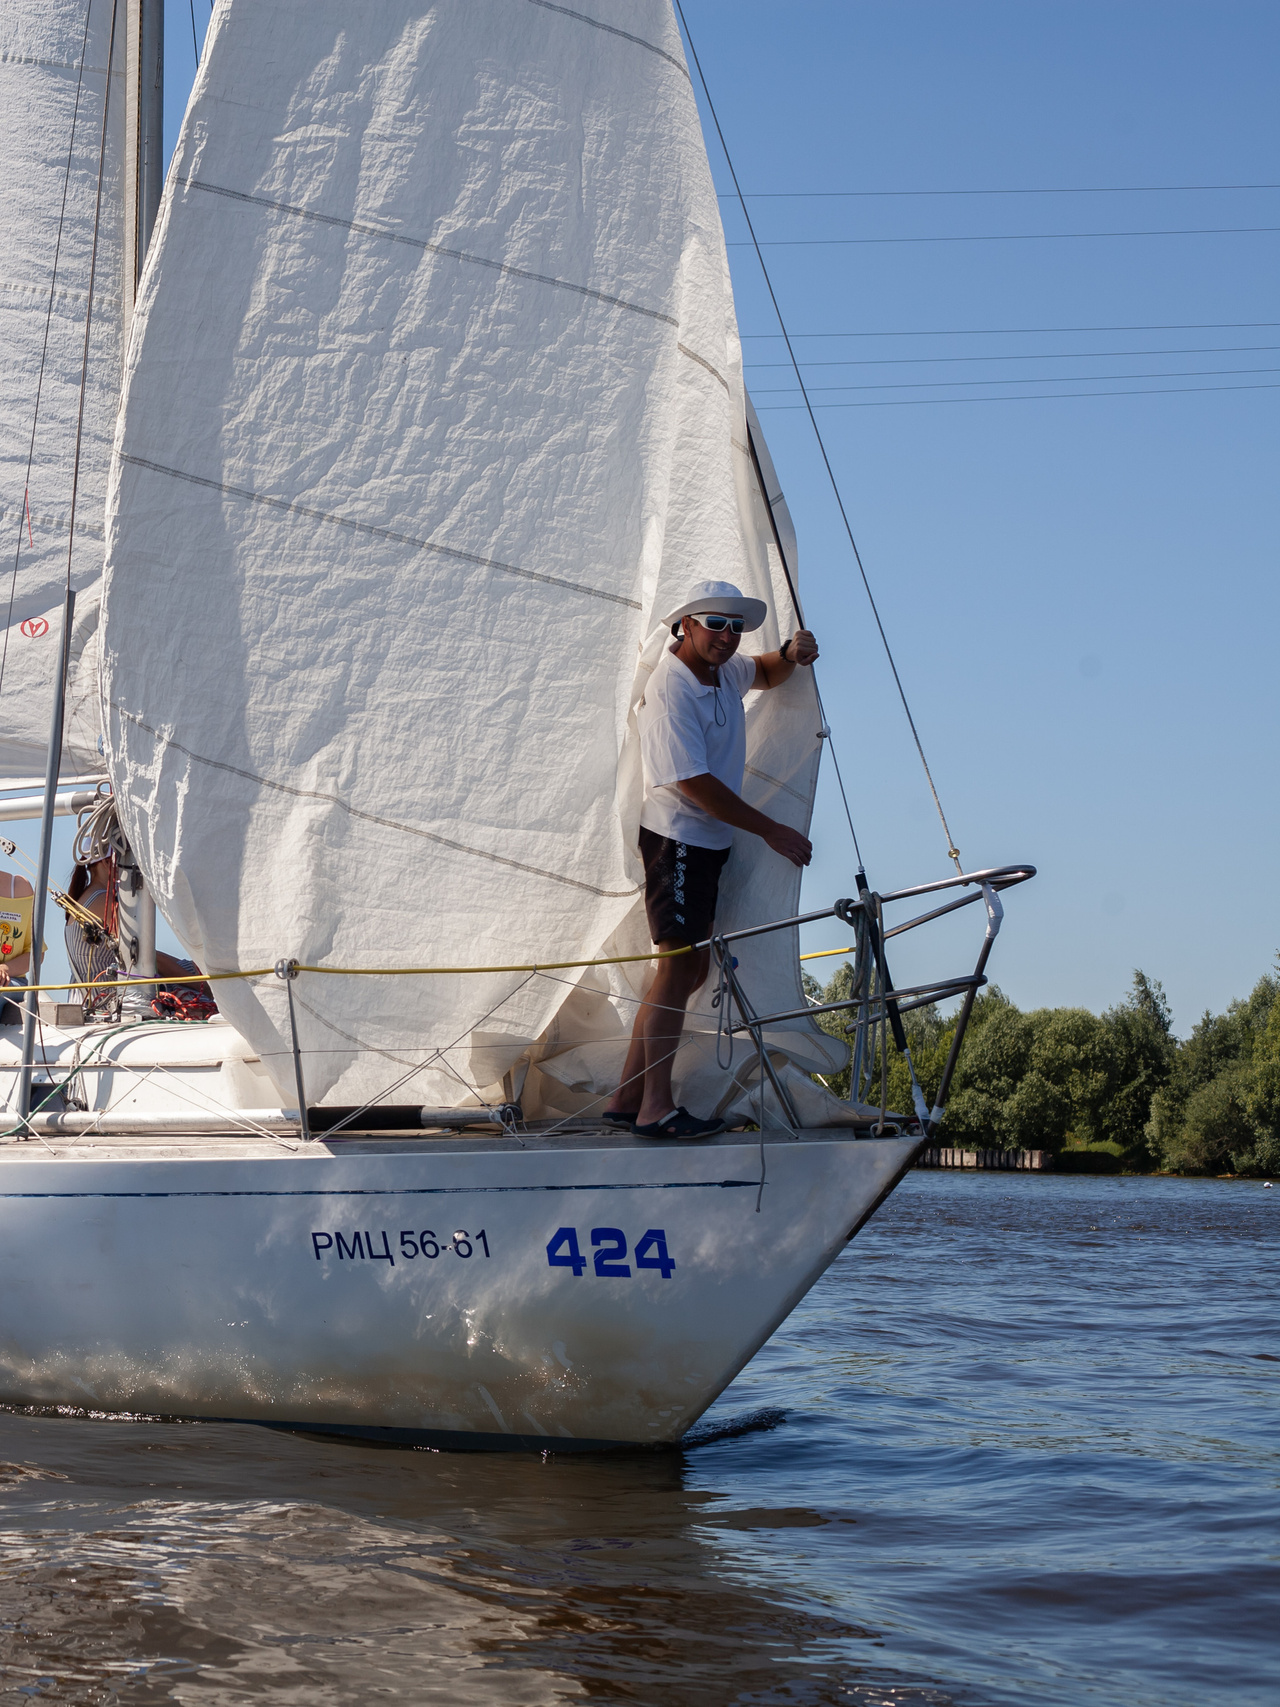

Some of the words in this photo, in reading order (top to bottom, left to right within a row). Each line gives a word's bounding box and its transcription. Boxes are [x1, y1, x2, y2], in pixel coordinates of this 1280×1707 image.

[311, 1231, 396, 1267] РМЦ
[399, 1228, 491, 1260] 56-61
[546, 1227, 677, 1280] 424
